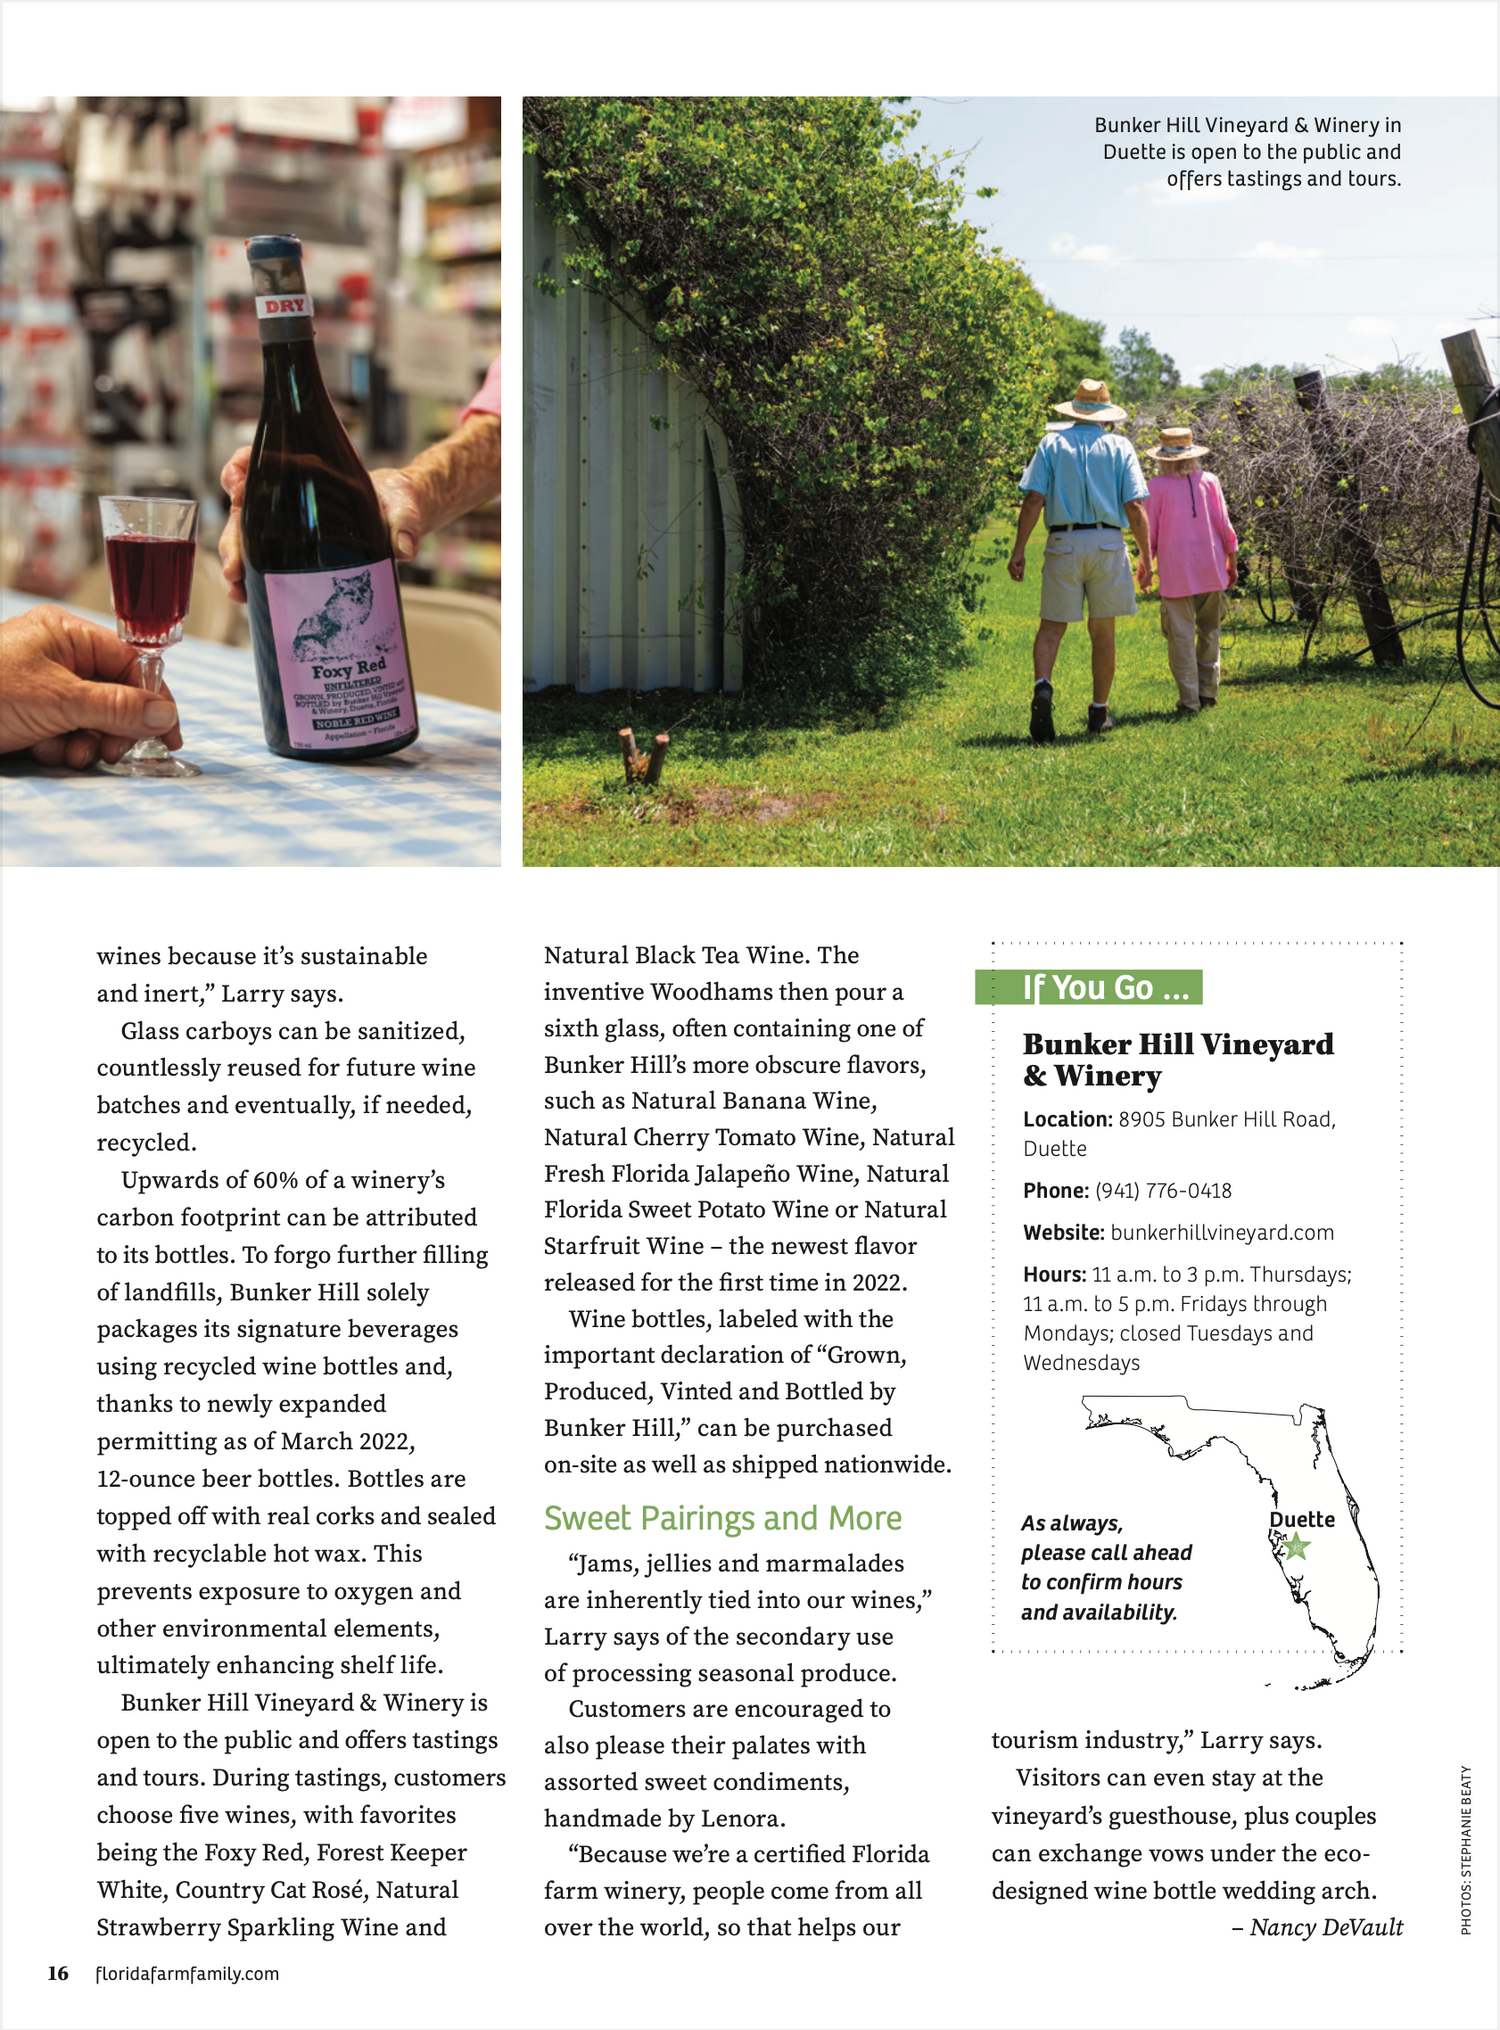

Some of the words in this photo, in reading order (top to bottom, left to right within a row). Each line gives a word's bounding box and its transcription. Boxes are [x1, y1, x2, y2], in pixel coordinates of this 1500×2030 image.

[265, 299, 304, 313] DRY
[312, 666, 353, 680] Foxy
[356, 656, 387, 674] Red
[324, 676, 382, 692] UNFILTERED
[316, 719, 352, 728] NOBLE
[353, 715, 374, 725] RED
[374, 709, 398, 721] WINE
[325, 731, 367, 741] Appellation
[97, 946, 161, 965] wines
[168, 946, 256, 965] because
[264, 946, 293, 965] it’s
[301, 946, 427, 965] sustainable
[545, 945, 628, 964] Natural
[636, 945, 696, 964] Black
[702, 947, 739, 964] Tea
[746, 945, 810, 964] Wine.
[818, 945, 859, 964] The
[1025, 974, 1046, 1003] If
[1052, 975, 1104, 999] You
[1115, 975, 1153, 999] Go
[1023, 1032, 1132, 1055] Bunker
[1139, 1032, 1194, 1054] Hill
[1200, 1032, 1335, 1062] Vineyard
[1024, 1065, 1047, 1086] &
[1053, 1064, 1162, 1093] Winery
[1025, 1110, 1112, 1127] Location:
[1120, 1111, 1165, 1127] 8905
[1173, 1111, 1238, 1127] Bunker
[1245, 1111, 1277, 1127] Hill
[1284, 1111, 1335, 1129] Road,
[1025, 1140, 1086, 1156] Duette
[122, 1170, 219, 1194] Upwards
[226, 1169, 249, 1188] of
[254, 1172, 298, 1189] 60%
[306, 1169, 329, 1188] of
[334, 1176, 345, 1188] a
[351, 1169, 445, 1194] winery’s
[545, 1164, 605, 1182] Fresh
[612, 1164, 690, 1182] Florida
[694, 1164, 790, 1188] Jalapeño
[797, 1164, 859, 1187] Wine,
[867, 1164, 949, 1182] Natural
[1025, 1182, 1089, 1198] Phone:
[1097, 1182, 1139, 1201] (941)
[1147, 1183, 1231, 1198] 776-0418
[1024, 1224, 1104, 1240] Website:
[1112, 1224, 1333, 1245] bunkerhillvineyard.com
[1025, 1266, 1086, 1282] Hours:
[1093, 1267, 1111, 1282] 11
[1117, 1270, 1156, 1282] a.m.
[1164, 1266, 1181, 1282] to
[1188, 1267, 1197, 1282] 3
[1205, 1270, 1244, 1286] p.m.
[1250, 1266, 1351, 1287] Thursdays;
[1024, 1296, 1042, 1311] 11
[1048, 1299, 1087, 1312] a.m.
[1095, 1295, 1111, 1312] to
[1119, 1296, 1128, 1311] 5
[1136, 1299, 1174, 1316] p.m.
[1182, 1295, 1246, 1316] Fridays
[1254, 1295, 1326, 1316] through
[1025, 1325, 1113, 1346] Mondays;
[1121, 1325, 1180, 1341] closed
[1187, 1325, 1272, 1346] Tuesdays
[1279, 1325, 1313, 1341] and
[1024, 1354, 1139, 1375] Wednesdays
[97, 1431, 217, 1455] permitting
[224, 1437, 247, 1450] as
[254, 1431, 277, 1450] of
[282, 1431, 353, 1450] March
[360, 1433, 414, 1455] 2022,
[545, 1505, 631, 1530] Sweet
[643, 1505, 754, 1537] Pairings
[765, 1505, 817, 1530] and
[830, 1506, 901, 1530] More
[1021, 1515, 1046, 1531] As
[1050, 1515, 1122, 1536] always,
[1270, 1511, 1335, 1528] Duette
[1021, 1544, 1085, 1565] please
[1091, 1544, 1127, 1560] call
[1133, 1544, 1193, 1560] ahead
[1022, 1573, 1041, 1590] to
[1047, 1573, 1122, 1594] confirm
[1128, 1573, 1183, 1590] hours
[1021, 1604, 1058, 1620] and
[1063, 1603, 1176, 1625] availability.
[992, 1730, 1078, 1748] tourism
[1085, 1729, 1193, 1754] industry,”
[1201, 1731, 1263, 1754] Larry
[1270, 1736, 1321, 1754] says.
[545, 1772, 638, 1790] assorted
[645, 1775, 707, 1790] sweet
[714, 1772, 849, 1795] condiments,
[1461, 1766, 1471, 1804] BEATY
[545, 1808, 661, 1827] handmade
[669, 1808, 695, 1833] by
[702, 1810, 785, 1827] Lenora.
[992, 1805, 1102, 1830] vineyard’s
[1109, 1806, 1237, 1830] guesthouse,
[1245, 1806, 1289, 1830] plus
[1296, 1806, 1376, 1830] couples
[1461, 1809, 1471, 1877] STEPHANIE
[993, 1881, 1088, 1905] designed
[1094, 1881, 1147, 1899] wine
[1153, 1881, 1216, 1899] bottle
[1222, 1881, 1315, 1905] wedding
[1322, 1881, 1376, 1899] arch.
[1461, 1881, 1471, 1935] PHOTOS:
[97, 1917, 221, 1941] Strawberry
[228, 1917, 334, 1941] Sparkling
[341, 1917, 398, 1936] Wine
[406, 1917, 447, 1936] and
[1250, 1919, 1317, 1941] Nancy
[1322, 1917, 1404, 1936] DeVault
[48, 1966, 68, 1980] 16
[97, 1966, 278, 1984] floridafarmfamily.com
